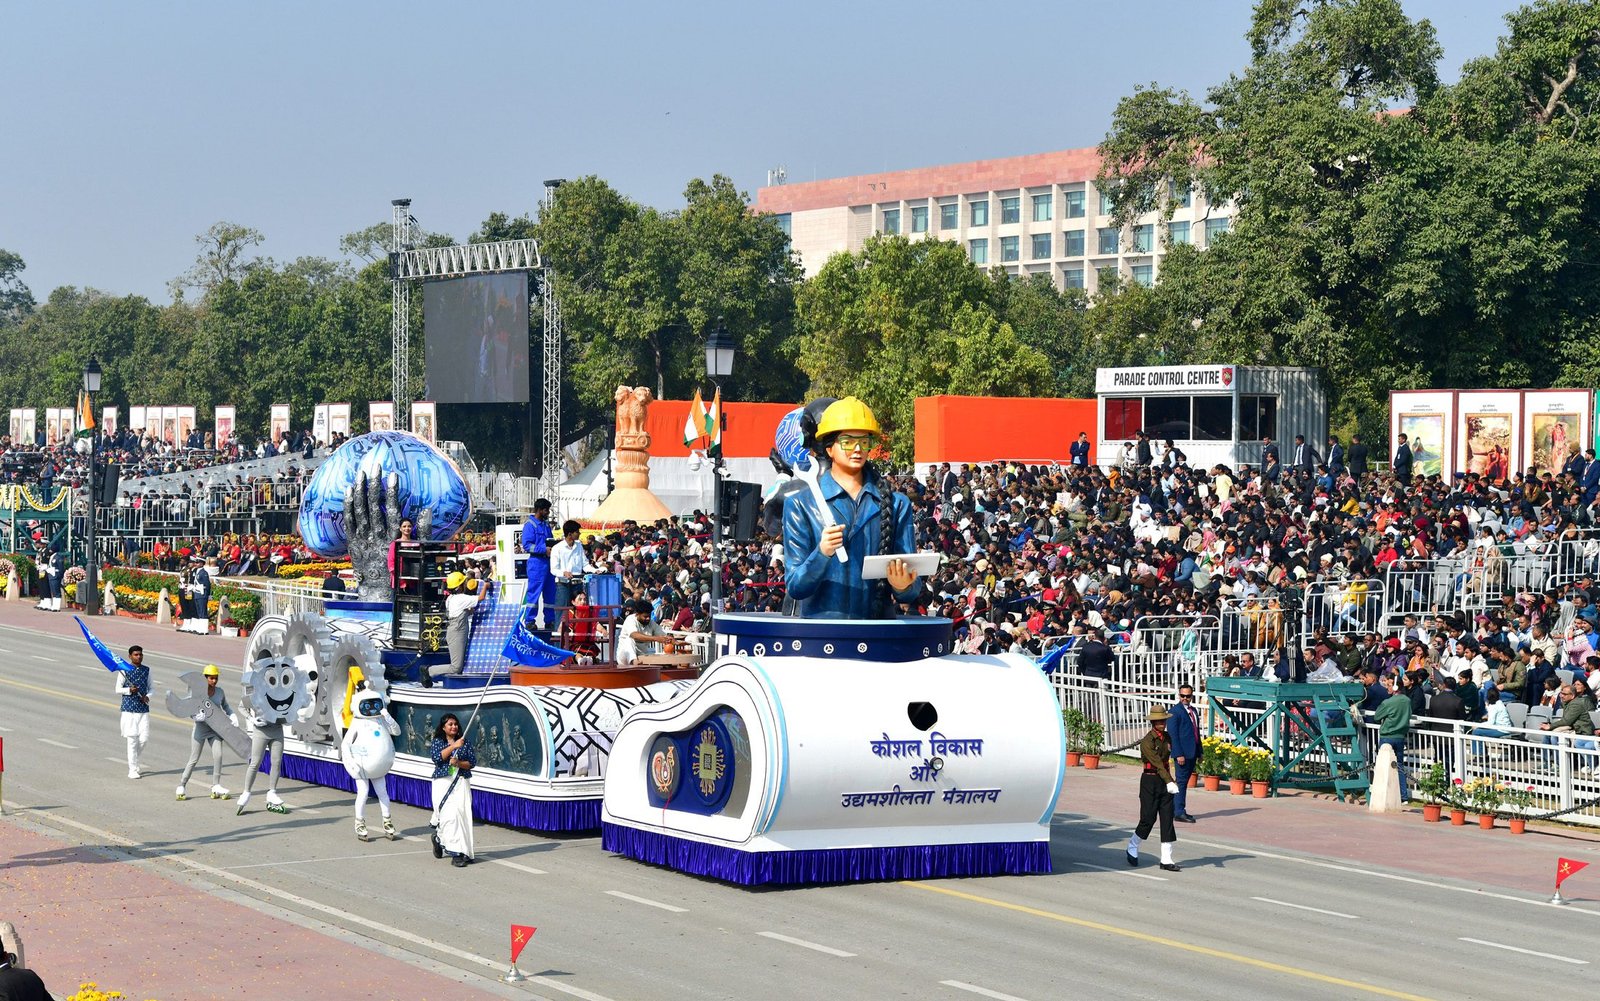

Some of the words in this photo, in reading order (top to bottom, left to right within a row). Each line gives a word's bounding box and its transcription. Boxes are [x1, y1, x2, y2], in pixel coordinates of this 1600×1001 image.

[1114, 372, 1146, 386] PARADE
[1147, 371, 1185, 386] CONTROL
[1187, 370, 1220, 385] CENTRE
[870, 732, 922, 757] कौशल
[929, 731, 984, 757] विकास
[909, 758, 939, 782] और
[841, 784, 936, 808] उद्यमशीलता
[942, 787, 1002, 806] मंत्रालय
